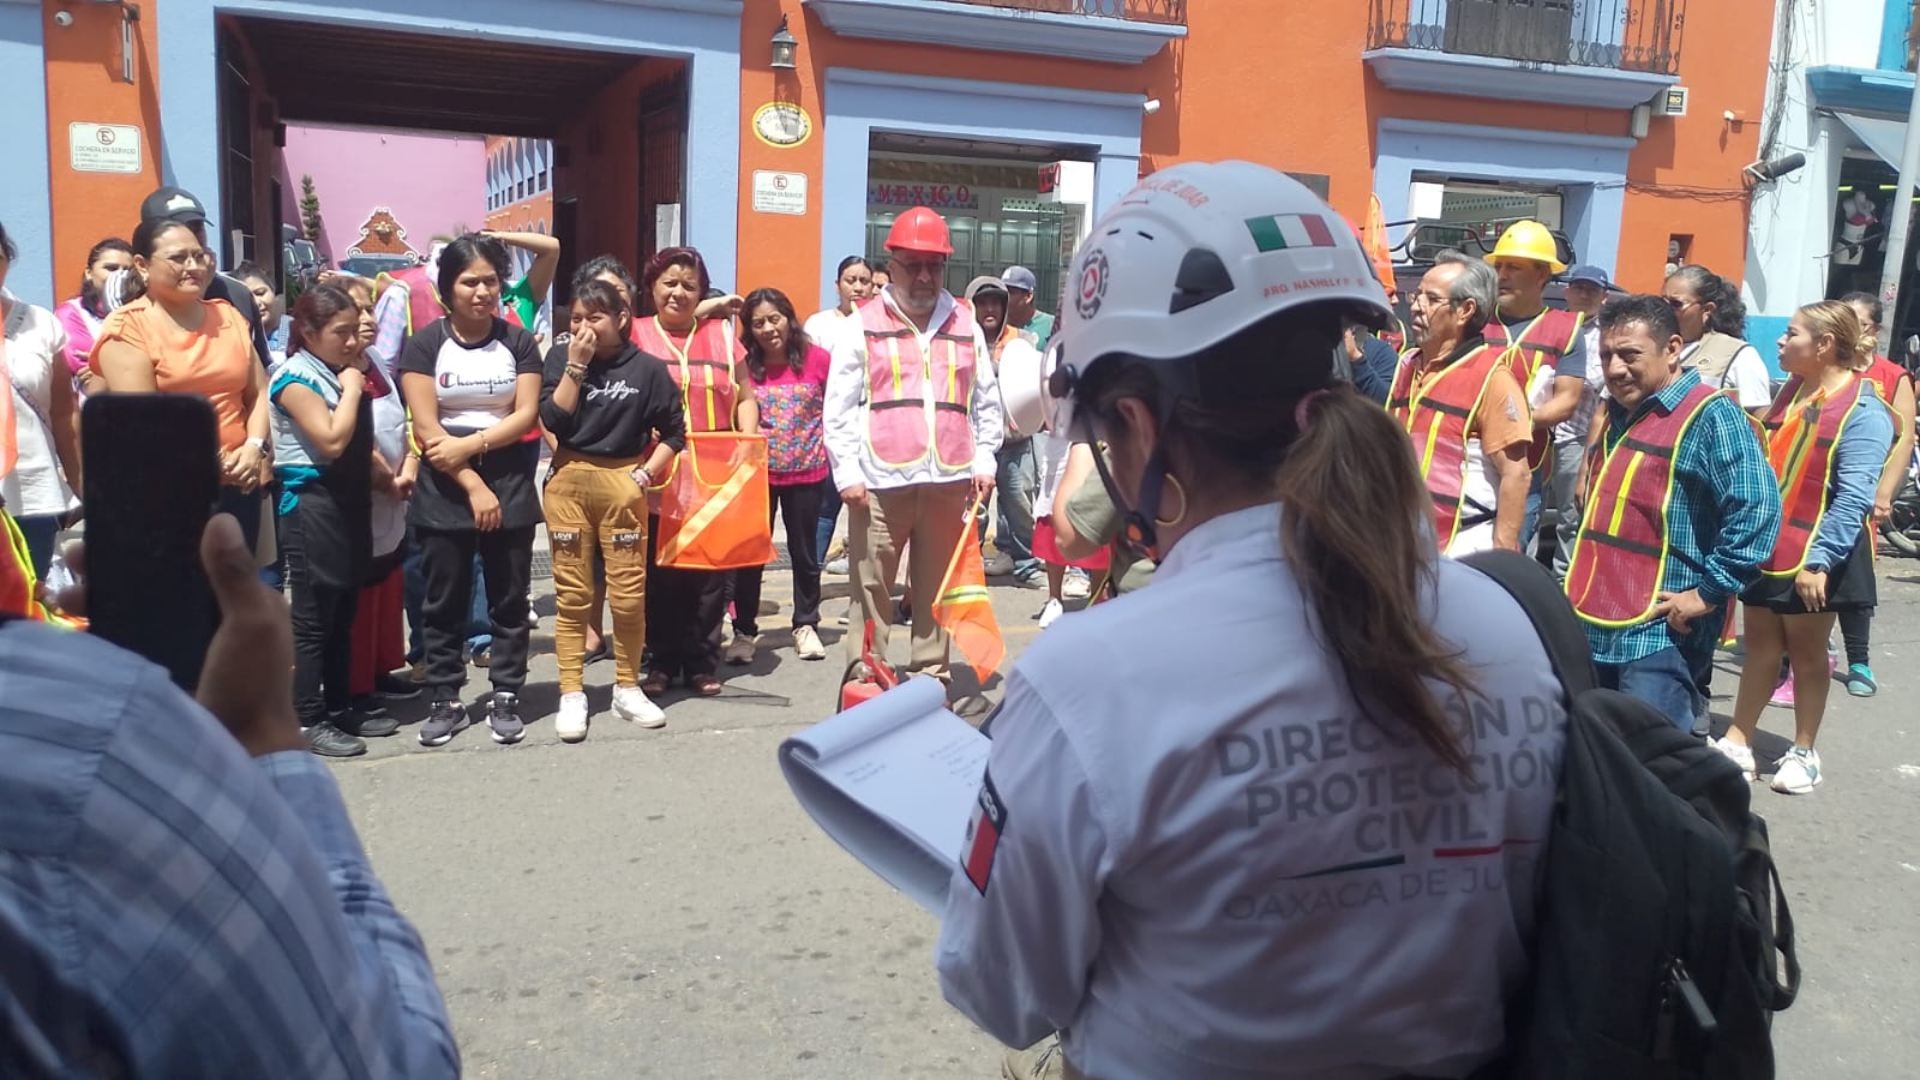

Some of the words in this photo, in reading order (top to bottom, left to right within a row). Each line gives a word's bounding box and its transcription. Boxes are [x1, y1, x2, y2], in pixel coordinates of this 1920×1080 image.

[1355, 802, 1488, 852] CIVIL
[1222, 879, 1389, 920] OAXACA
[1401, 867, 1448, 901] DE
